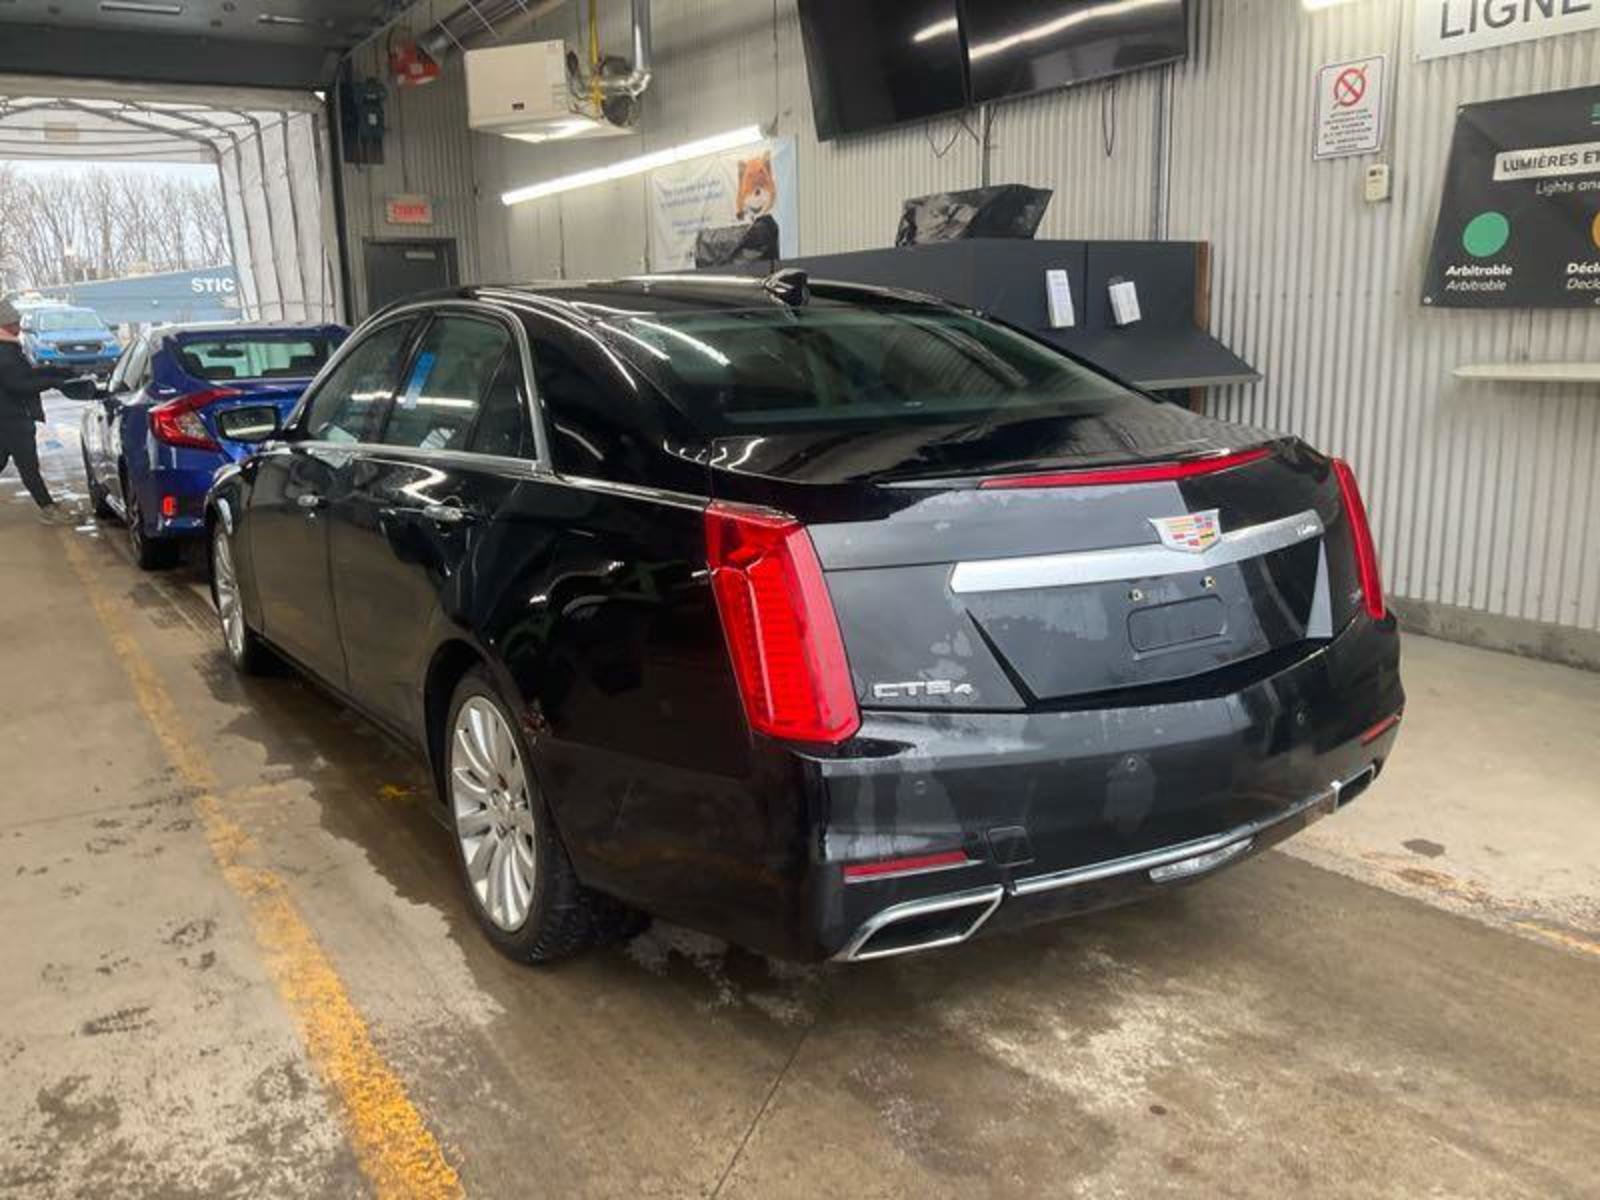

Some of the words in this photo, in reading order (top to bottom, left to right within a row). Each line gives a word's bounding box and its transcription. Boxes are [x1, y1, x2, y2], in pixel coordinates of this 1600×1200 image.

[1503, 152, 1578, 172] LUMIÈRES
[1536, 180, 1574, 197] Lights
[1446, 264, 1513, 276] Arbitrable
[191, 277, 234, 292] STIC
[1446, 280, 1507, 291] Arbitrable
